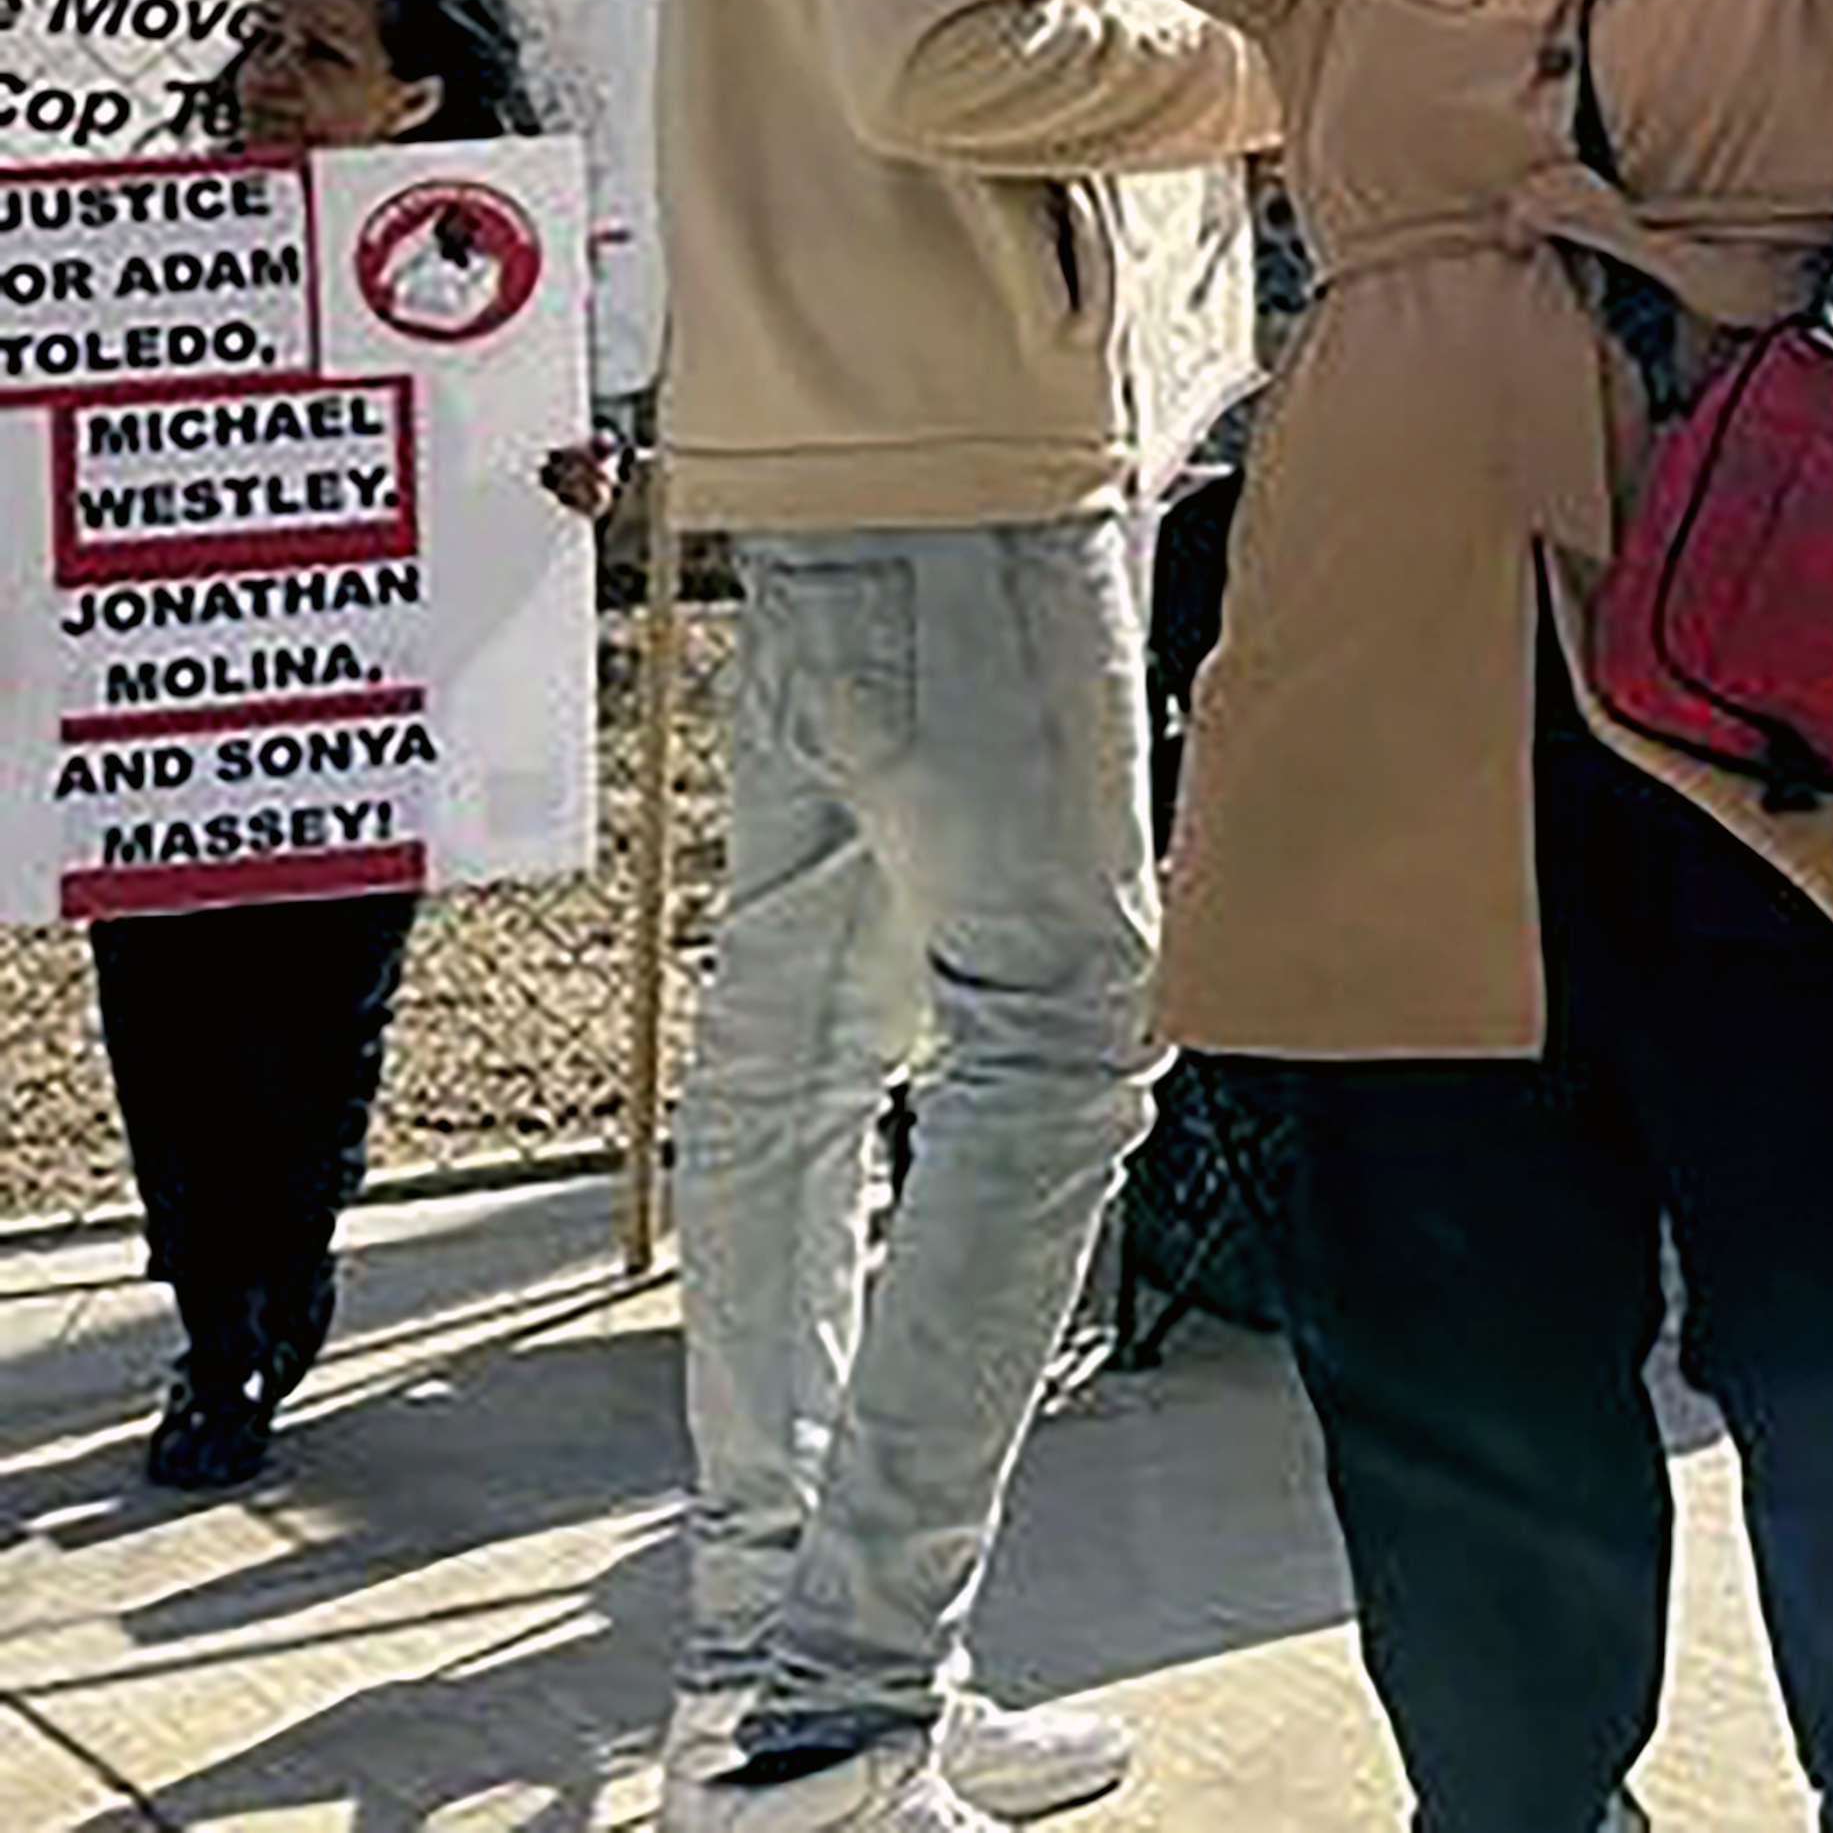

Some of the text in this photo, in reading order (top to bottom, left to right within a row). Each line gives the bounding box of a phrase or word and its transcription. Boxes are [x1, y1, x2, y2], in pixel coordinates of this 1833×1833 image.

[0, 245, 301, 306] OR ADAM
[89, 396, 385, 456] MICHAEL
[60, 565, 421, 637] JONATHAN
[55, 724, 438, 800] AND SONYA
[102, 801, 394, 868] MASSEY!
